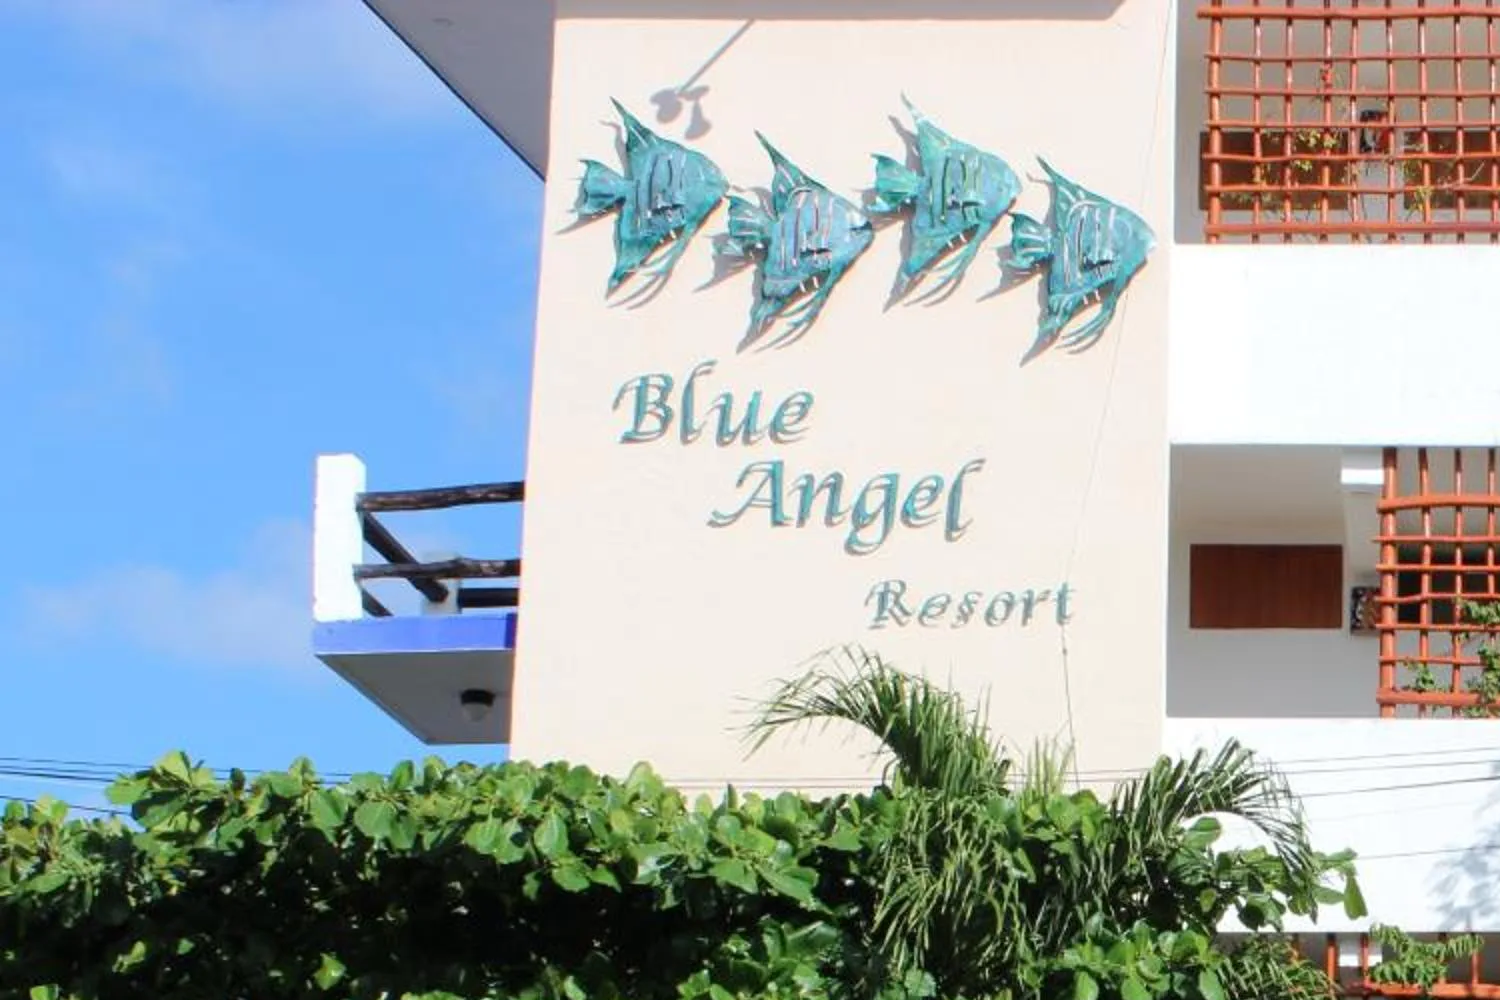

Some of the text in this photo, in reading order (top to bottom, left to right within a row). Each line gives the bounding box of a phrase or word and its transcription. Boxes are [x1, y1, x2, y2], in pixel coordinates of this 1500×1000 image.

[613, 361, 814, 446] Blue
[707, 458, 986, 556] Angel
[864, 578, 1076, 629] Resort
